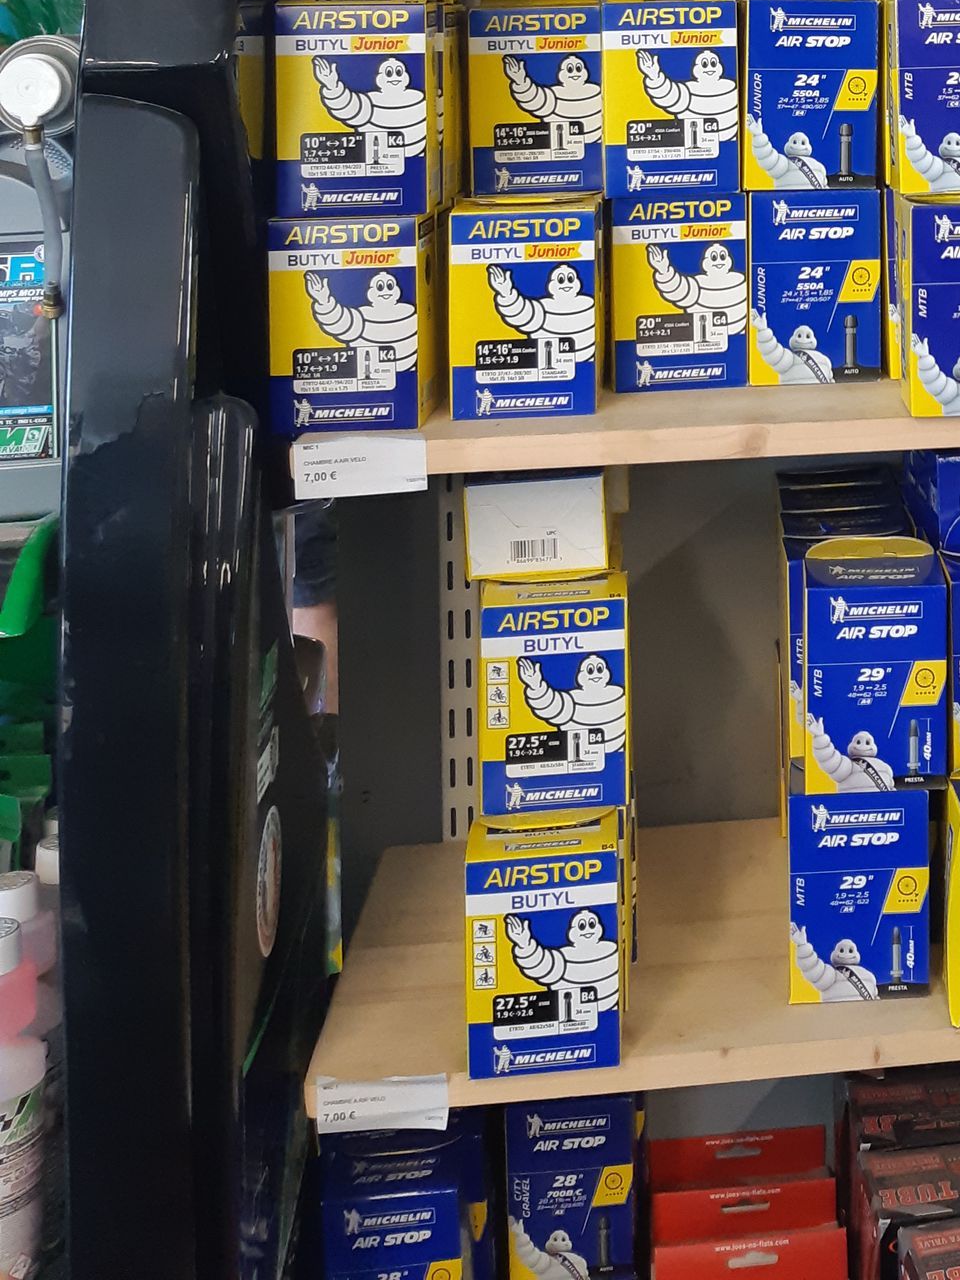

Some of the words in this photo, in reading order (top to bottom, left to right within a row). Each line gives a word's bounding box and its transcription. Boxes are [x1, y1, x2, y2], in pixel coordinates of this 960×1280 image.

[292, 9, 409, 30] AIRSTOP
[484, 13, 587, 32] AIRSTOP
[618, 7, 722, 26] AIRSTOP
[788, 16, 853, 26] MICHELIN
[295, 38, 348, 52] BUTYL
[353, 37, 404, 52] Junior
[487, 39, 534, 51] BUTYL
[538, 37, 583, 50] Junior
[621, 33, 669, 45] BUTYL
[673, 31, 717, 44] Junior
[775, 36, 802, 47] AIR
[805, 35, 851, 48] STOP
[794, 74, 826, 86] 24"
[904, 72, 913, 100] MTB
[753, 73, 762, 115] JUNIOR
[629, 200, 732, 220] AIRSTOP
[285, 223, 400, 245] AIRSTOP
[468, 218, 581, 239] AIRSTOP
[287, 253, 340, 267] BUTYL
[344, 251, 395, 266] Junior
[303, 472, 327, 483] 7,00
[329, 470, 337, 481] €
[848, 604, 919, 616] MICHELIN
[498, 607, 610, 632] AIRSTOP
[836, 626, 865, 640] AIR
[868, 624, 918, 639] STOP
[524, 637, 584, 653] BUTYL
[857, 667, 892, 682] 29"
[484, 859, 602, 889] AIRSTOP
[514, 1048, 592, 1065] MICHELIN
[323, 1112, 346, 1123] 7,00
[543, 1118, 607, 1131] MICHELIN
[533, 1139, 559, 1152] AIR
[561, 1136, 606, 1150] STOP
[879, 1180, 959, 1209] TUBE
